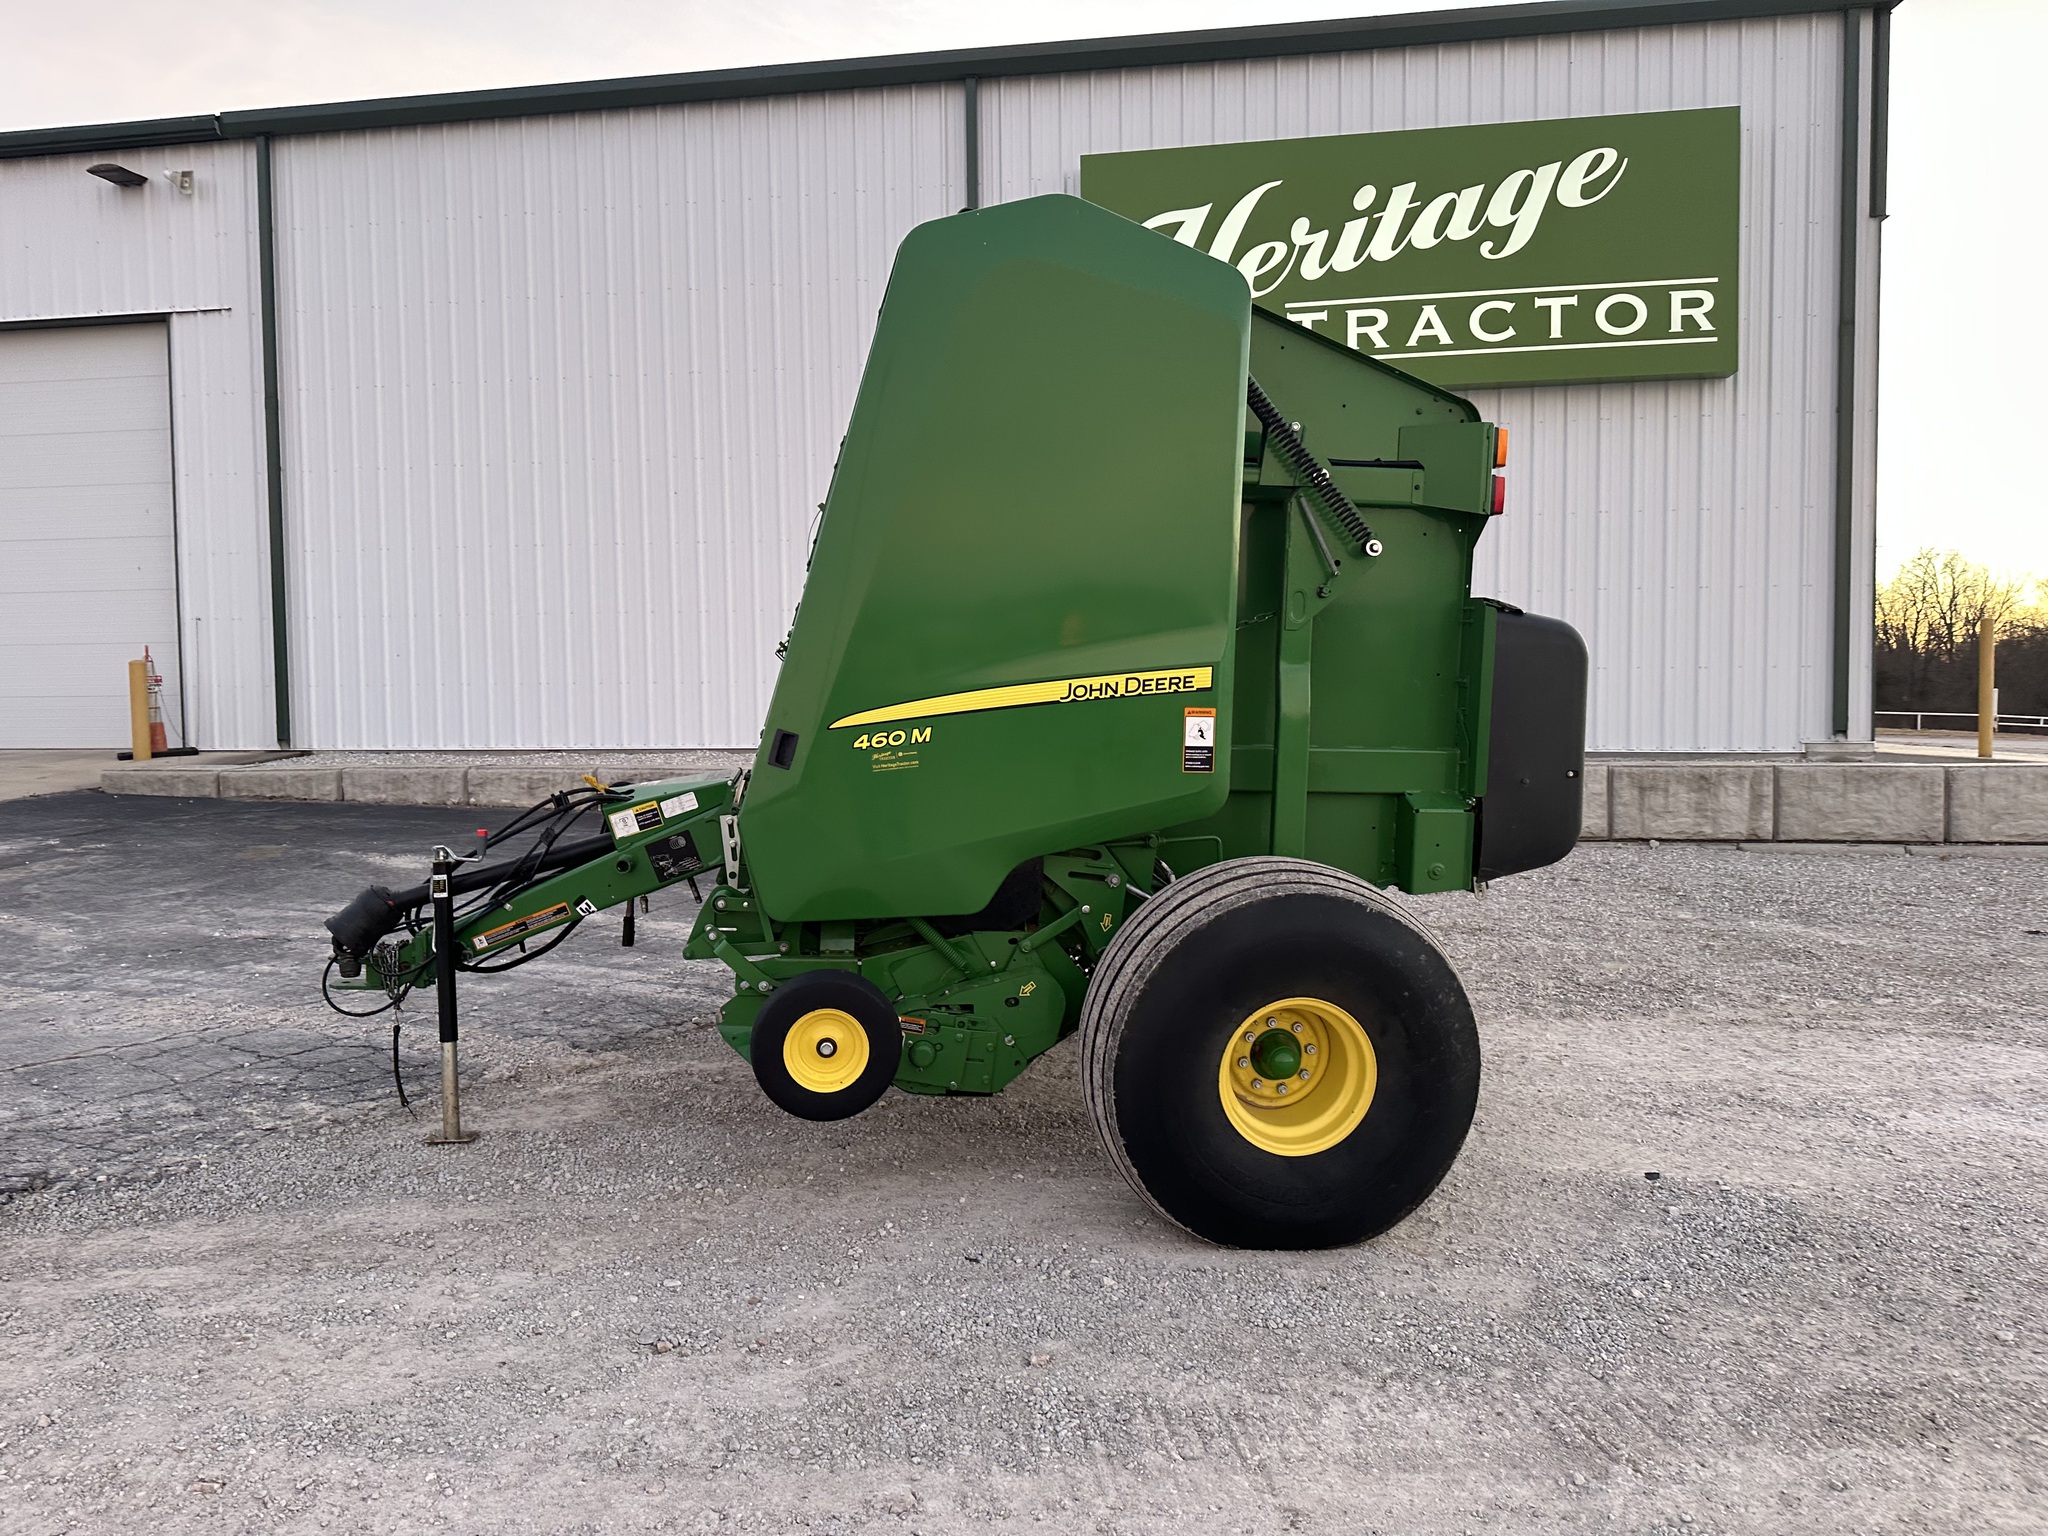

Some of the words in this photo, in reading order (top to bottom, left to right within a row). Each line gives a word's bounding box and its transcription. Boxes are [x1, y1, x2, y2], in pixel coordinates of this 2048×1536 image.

[1060, 682, 1119, 700] JOHN
[1125, 675, 1195, 693] DEERE
[852, 730, 906, 749] 460
[911, 727, 932, 744] M
